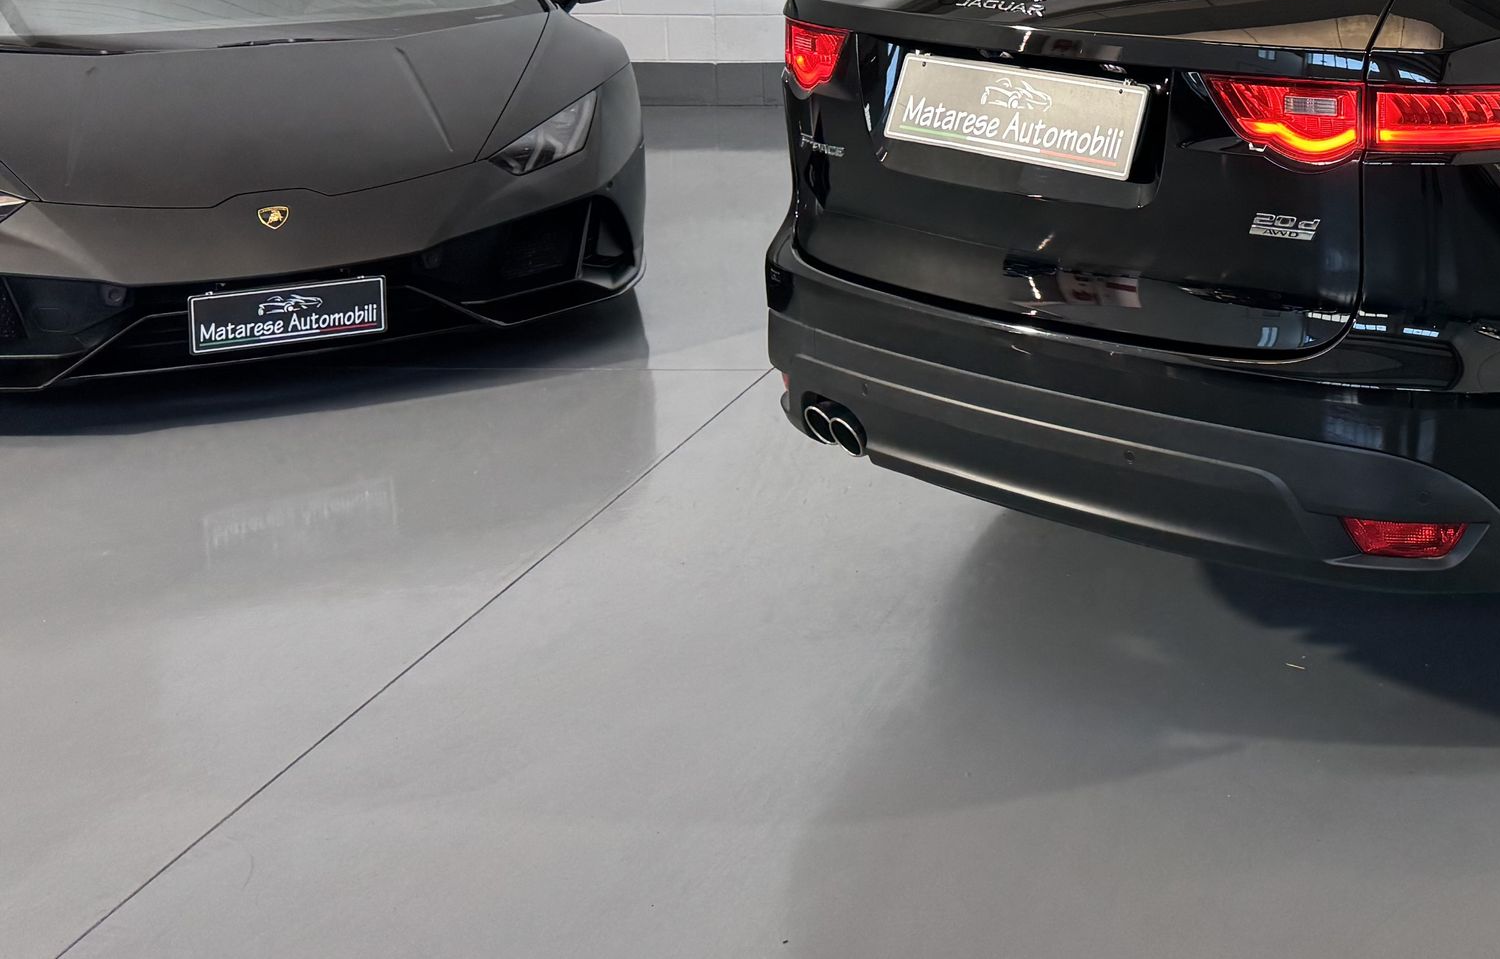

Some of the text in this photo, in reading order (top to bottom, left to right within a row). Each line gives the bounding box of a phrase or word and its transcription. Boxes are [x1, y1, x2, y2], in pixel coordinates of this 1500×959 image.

[902, 95, 1125, 160] Matarese Automobili
[1253, 212, 1320, 230] 20d
[1262, 229, 1299, 238] AWD
[199, 304, 377, 342] Matarese Automobili
